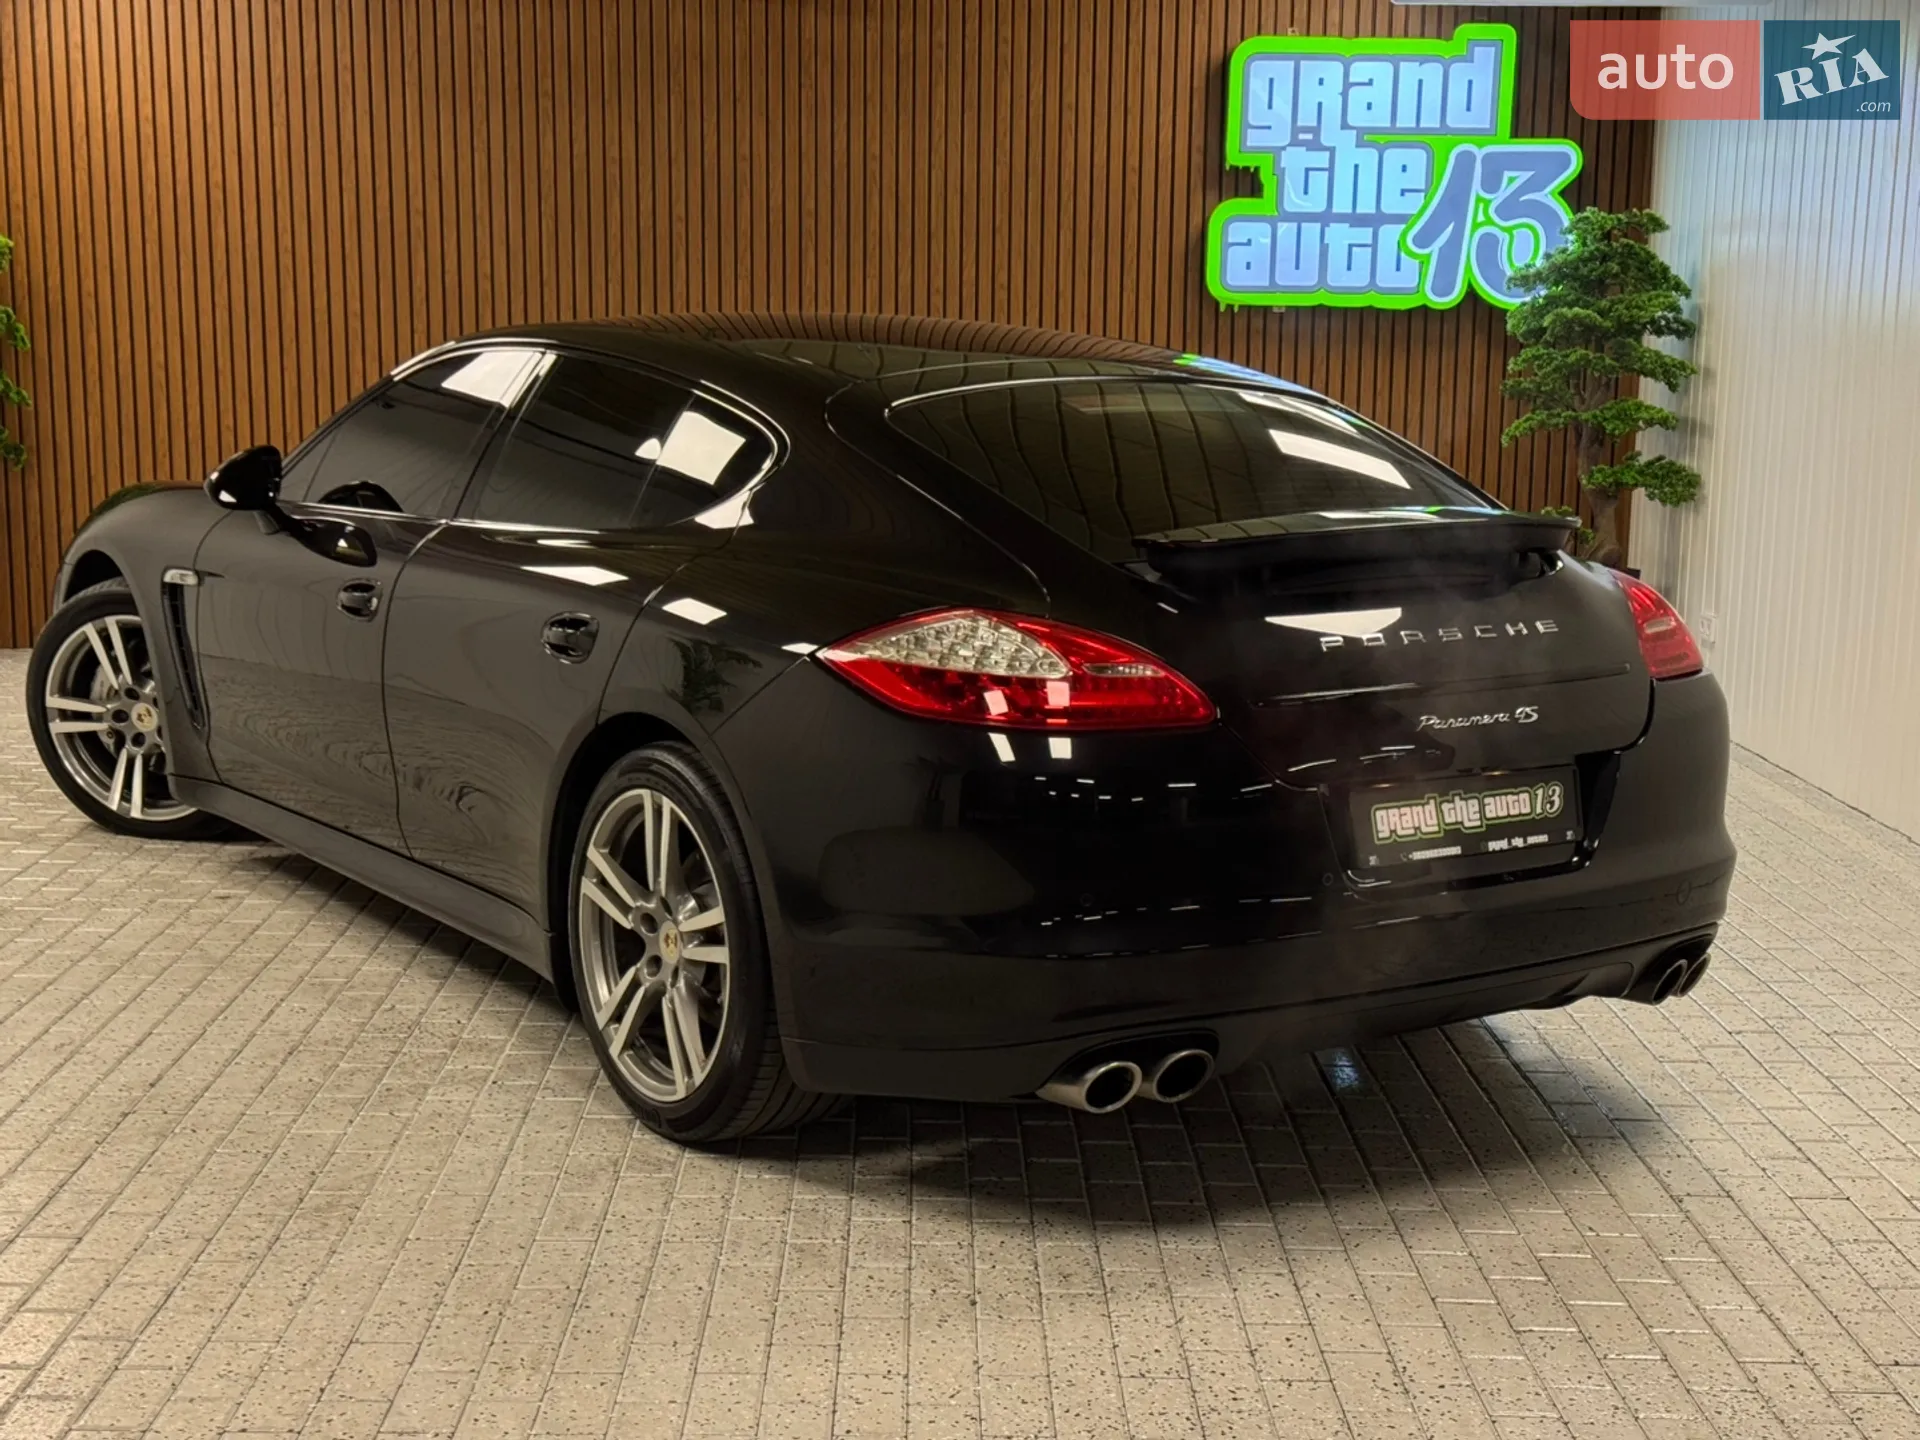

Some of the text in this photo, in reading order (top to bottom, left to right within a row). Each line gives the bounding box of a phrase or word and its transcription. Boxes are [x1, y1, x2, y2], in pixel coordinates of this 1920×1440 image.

[1281, 130, 1428, 214] the
[1226, 143, 1574, 303] auto 13
[1319, 620, 1559, 652] PORSCHE
[1417, 706, 1539, 731] Panamera 4S
[1440, 793, 1482, 828] the
[1483, 791, 1532, 819] auto
[1534, 785, 1562, 815] 13
